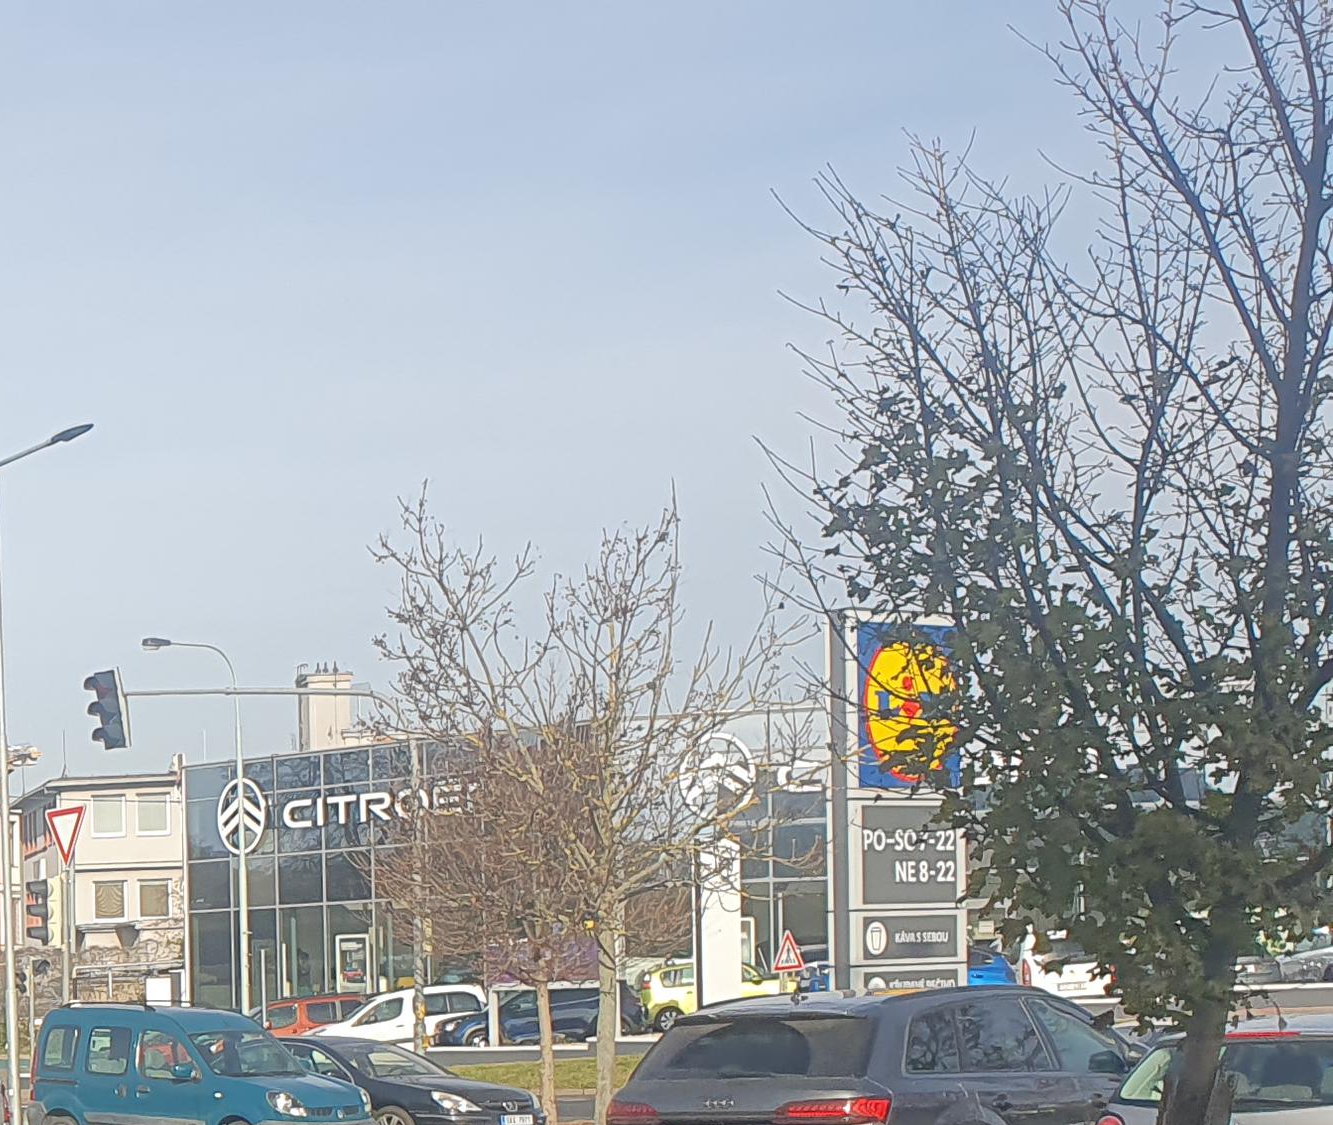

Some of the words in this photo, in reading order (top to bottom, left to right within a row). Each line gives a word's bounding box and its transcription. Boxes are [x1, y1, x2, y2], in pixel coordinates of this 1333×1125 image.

[894, 860, 917, 882] NE
[919, 860, 955, 882] 8-22
[894, 930, 916, 943] KÁVA
[922, 931, 949, 943] SEBOU
